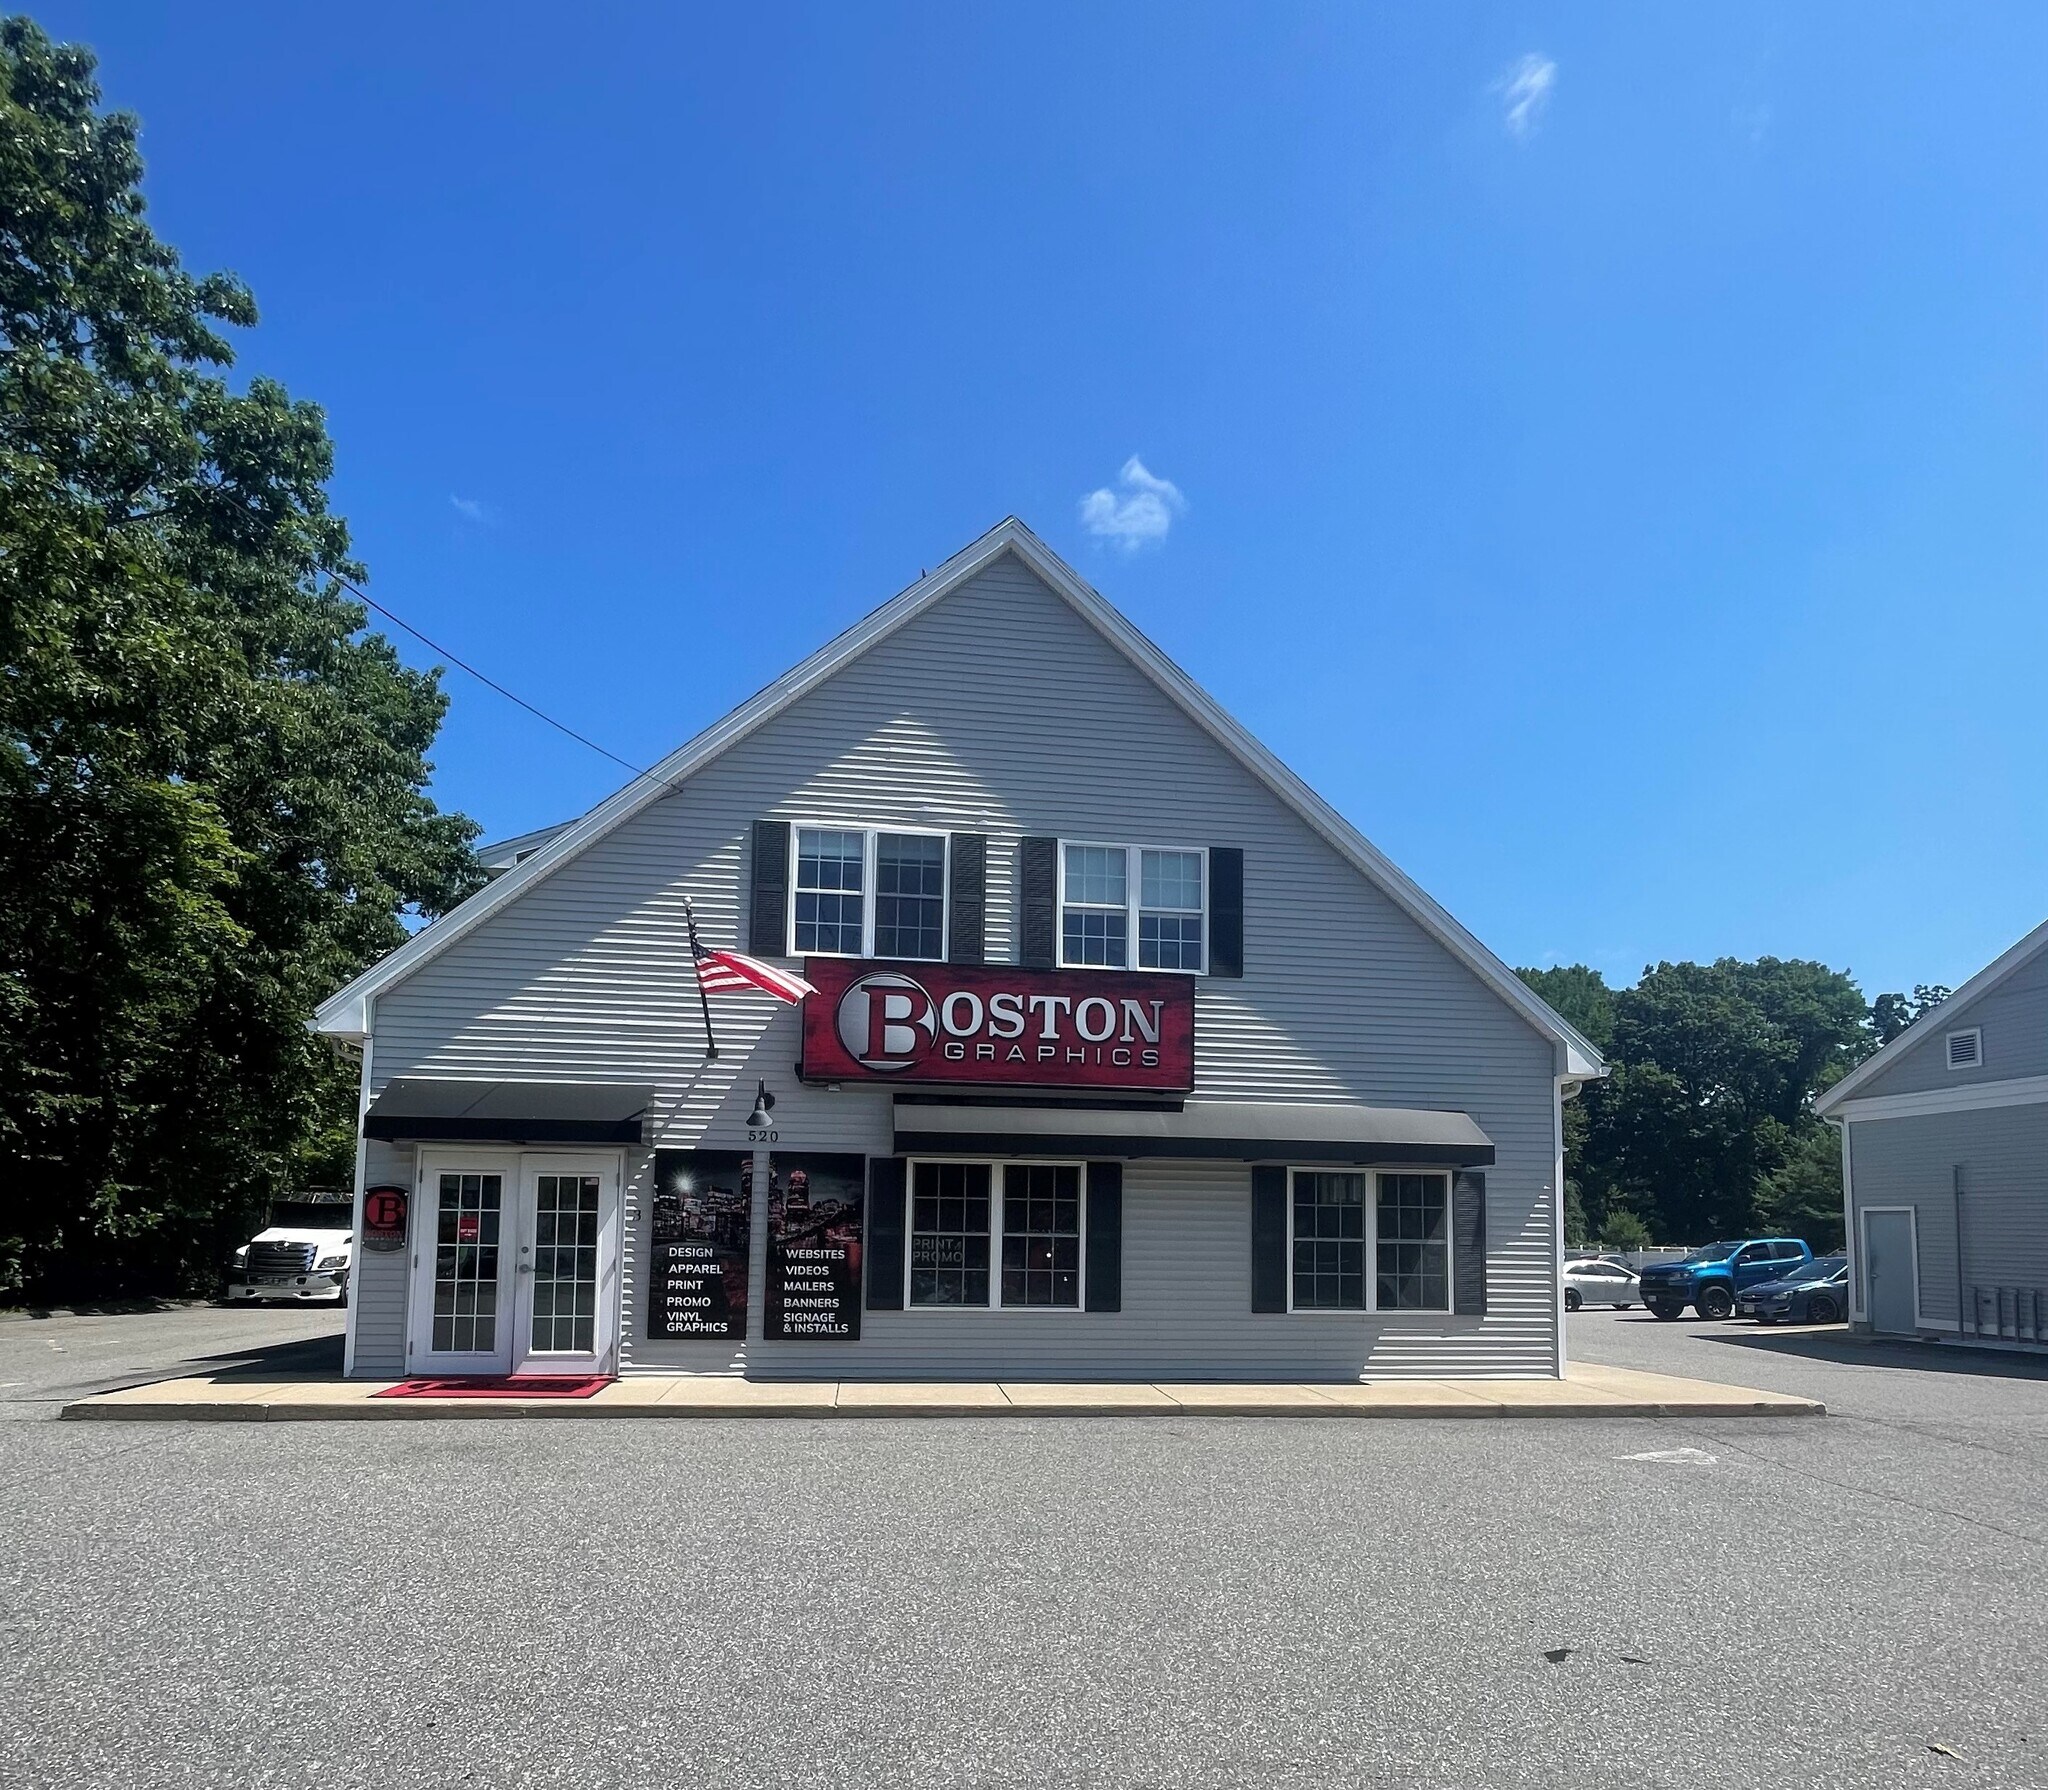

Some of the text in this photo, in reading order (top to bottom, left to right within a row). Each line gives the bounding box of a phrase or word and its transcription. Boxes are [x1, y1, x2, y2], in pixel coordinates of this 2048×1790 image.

[859, 985, 1164, 1062] BOSTON
[945, 1042, 1159, 1066] GRAPHICS
[748, 1130, 778, 1142] 520
[913, 1238, 954, 1250] PRINT
[668, 1247, 713, 1257] DESIGN
[786, 1249, 845, 1259] WEBSITES
[912, 1251, 963, 1263] PROMO
[668, 1264, 723, 1274] APPAREL
[785, 1265, 830, 1275] VIDEOS
[667, 1280, 703, 1290] PRINT
[784, 1281, 835, 1291] MAILERS
[666, 1297, 711, 1307] PROMO
[783, 1298, 840, 1308] BANNERS
[666, 1311, 702, 1321] VINYL
[783, 1312, 836, 1322] SIGNAGE
[666, 1322, 728, 1332] GRAPHICS
[783, 1323, 849, 1333] & INSTALLS
